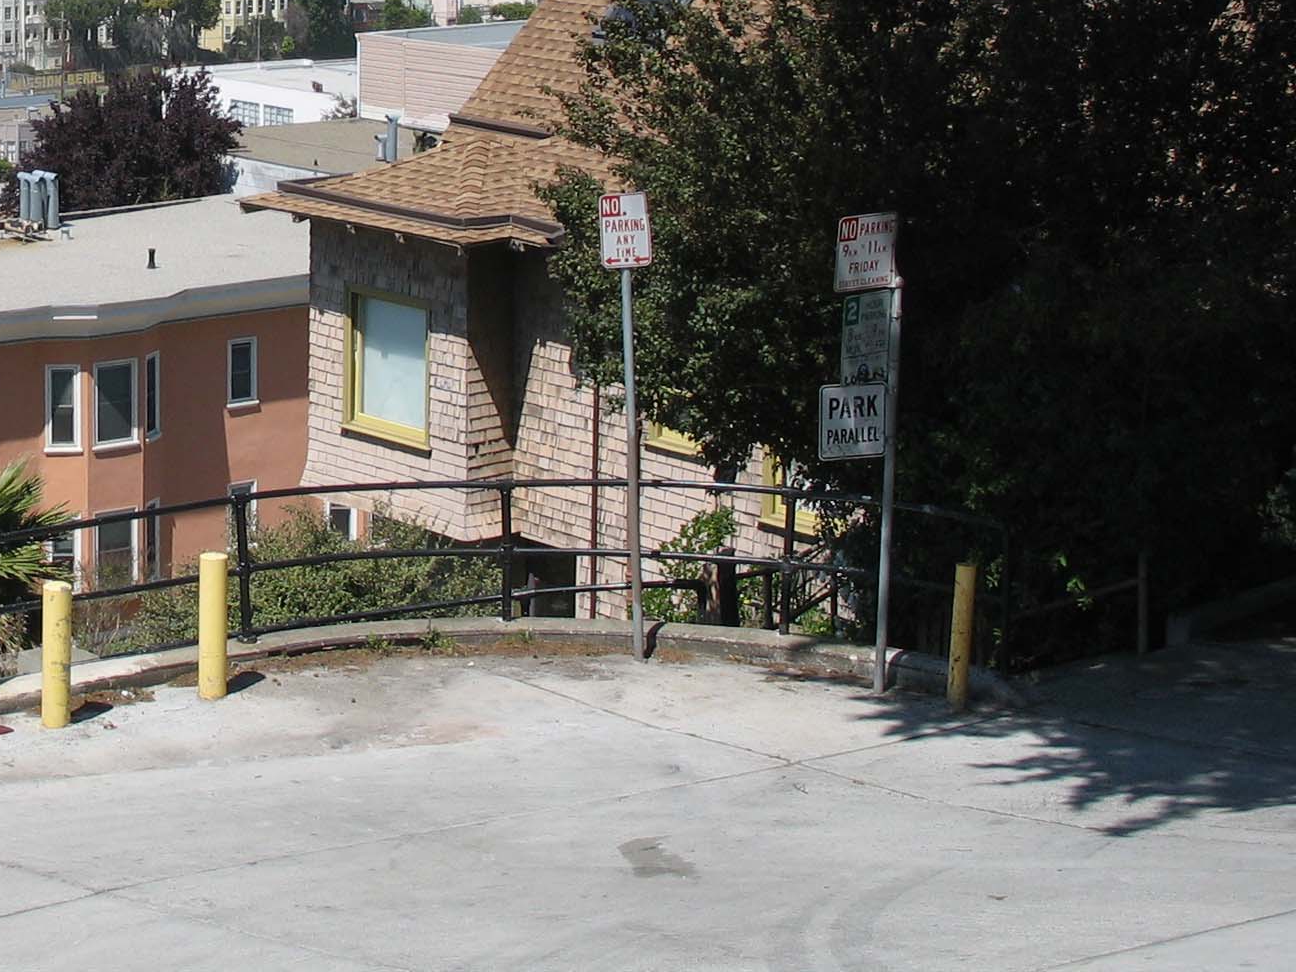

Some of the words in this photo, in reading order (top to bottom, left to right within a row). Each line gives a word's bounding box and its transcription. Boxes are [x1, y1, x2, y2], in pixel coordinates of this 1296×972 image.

[602, 198, 619, 215] NO
[604, 218, 645, 233] PARKING
[841, 220, 857, 240] NO
[859, 219, 896, 237] PARKING
[616, 234, 635, 245] ANY
[616, 247, 636, 258] TIME
[849, 259, 880, 275] FRIDAY
[848, 302, 857, 320] 2
[828, 394, 878, 420] PARK
[827, 426, 880, 445] PARALLEL
